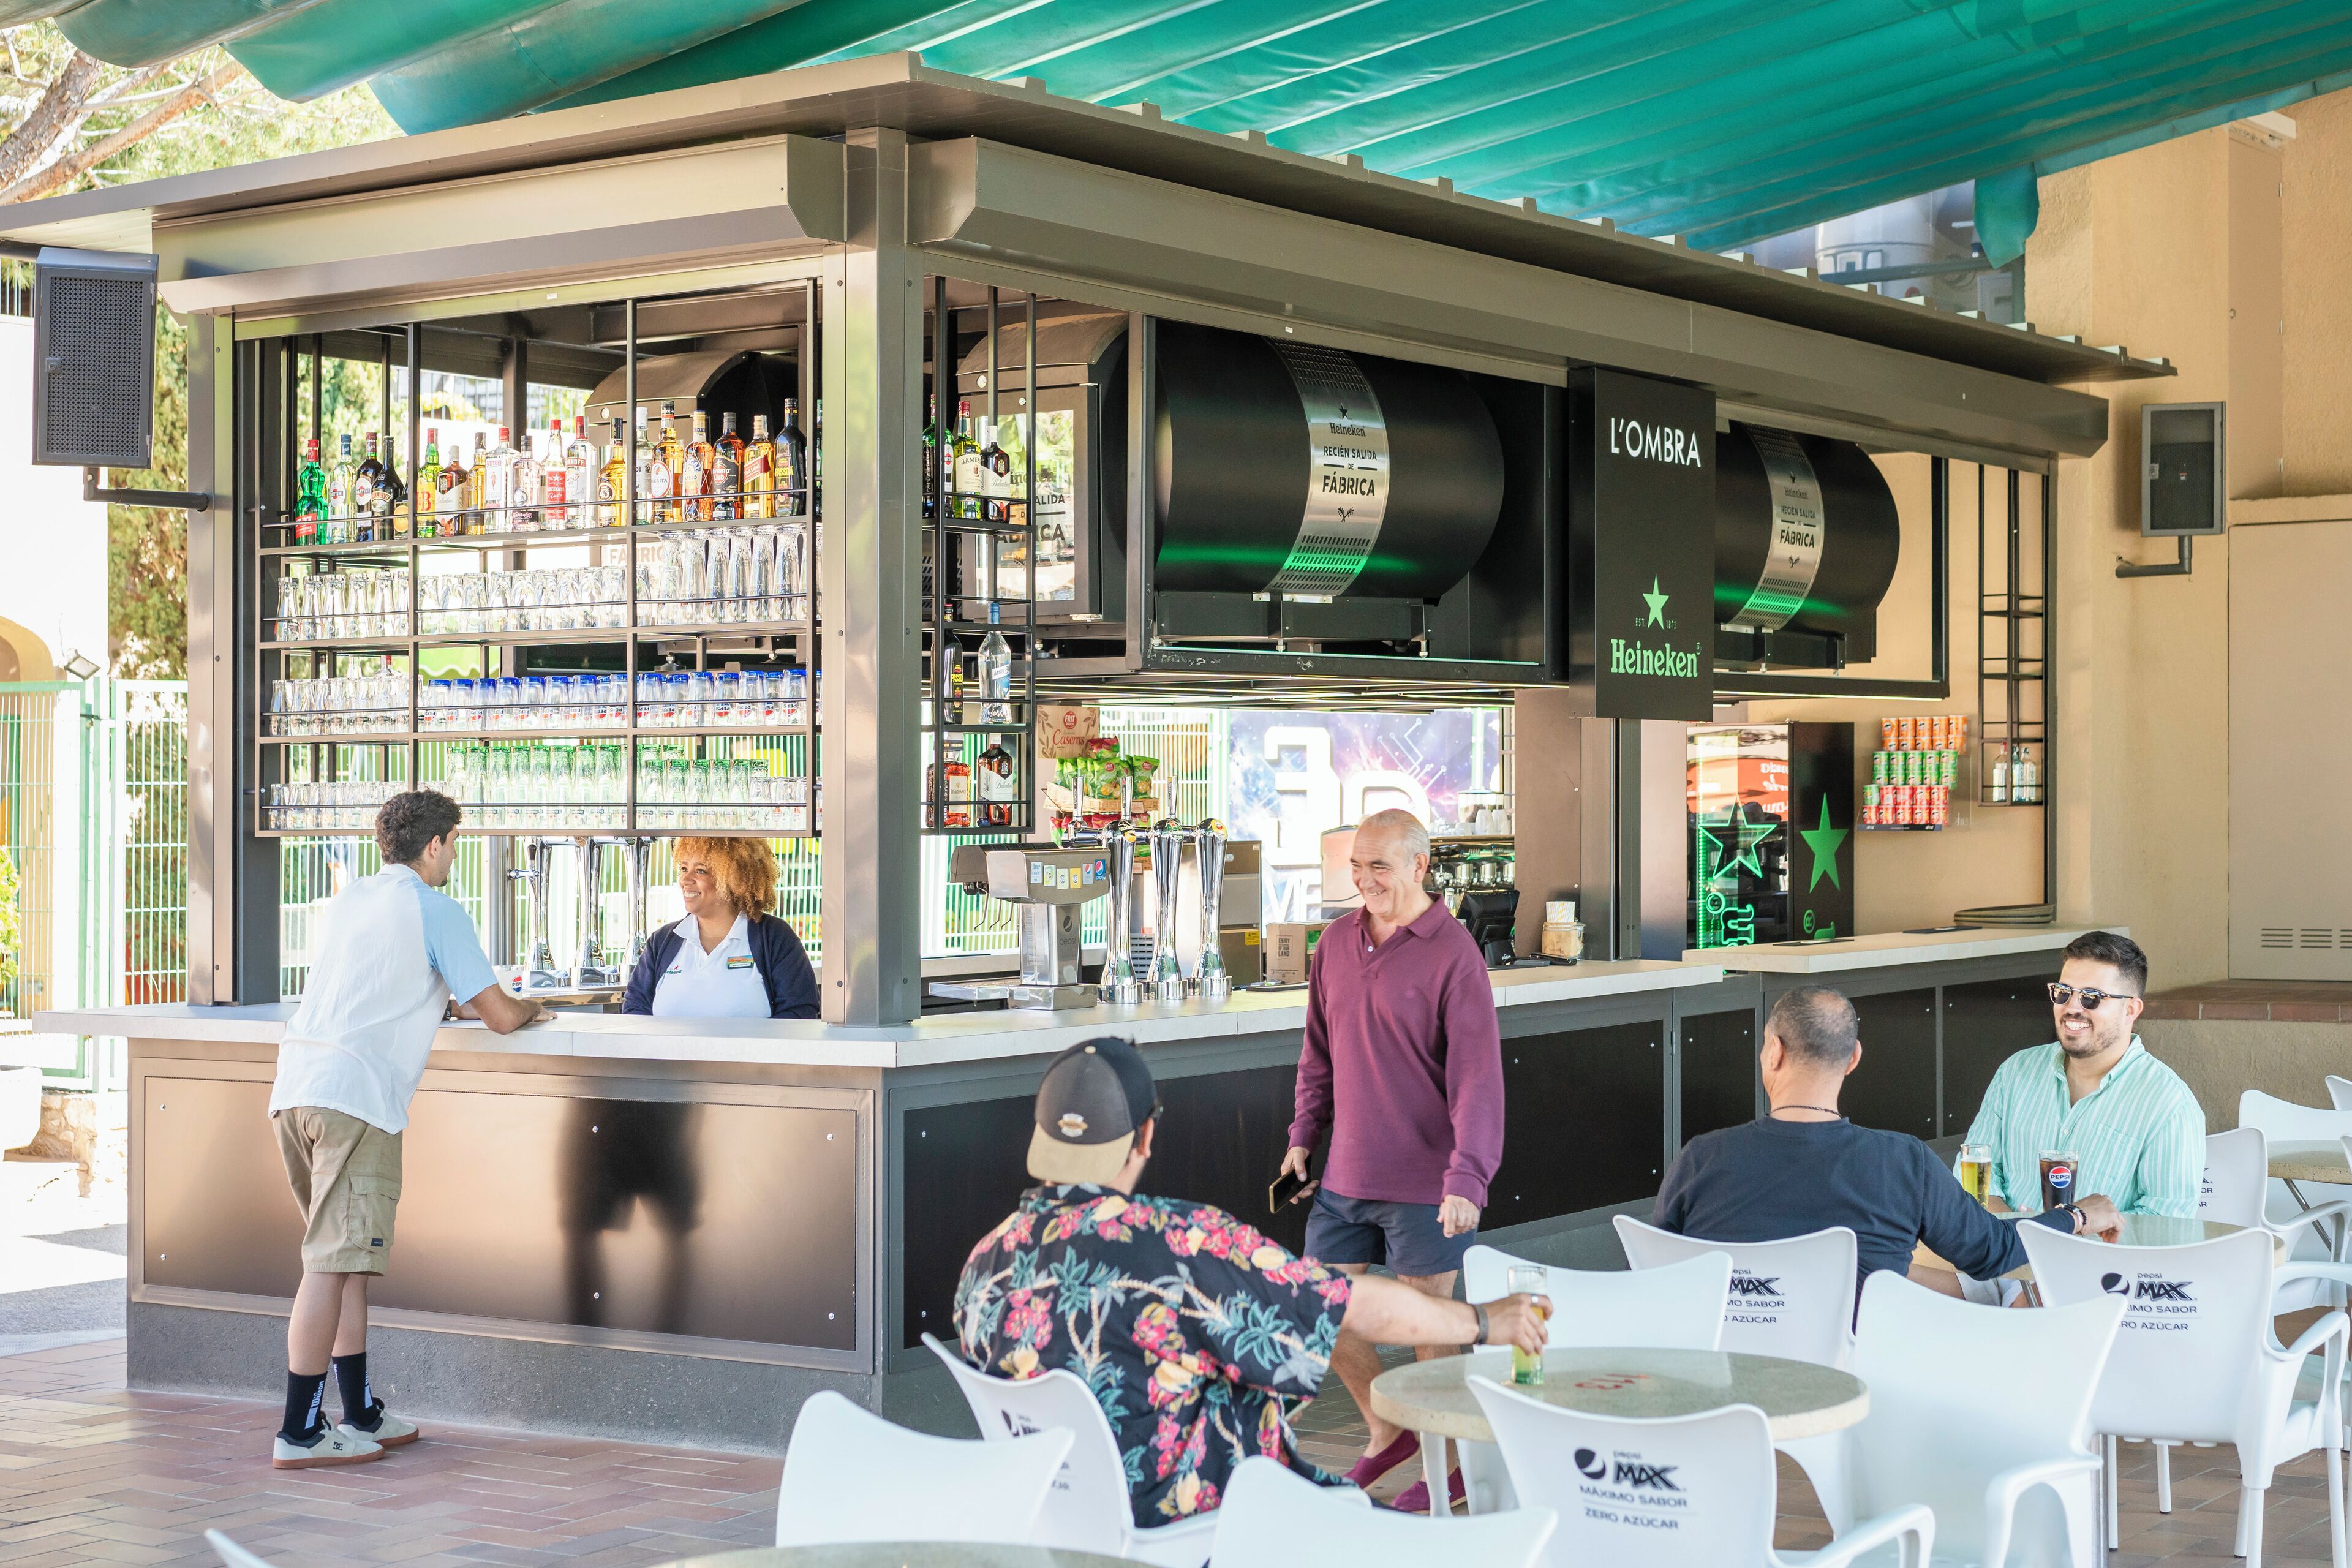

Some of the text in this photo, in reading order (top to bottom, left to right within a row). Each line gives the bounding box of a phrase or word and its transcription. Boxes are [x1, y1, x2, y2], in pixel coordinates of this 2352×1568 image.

[1329, 422, 1366, 437] Heineken
[1611, 417, 1702, 467] L'OMBRA
[1324, 445, 1377, 461] RECIÉN SALIDA
[1322, 471, 1375, 496] FÁBRICA
[1035, 494, 1065, 506] ALIDA
[1781, 505, 1816, 519] RECIÉN SALIDA
[1779, 526, 1814, 548] FÁBRICA
[1611, 639, 1698, 678] Heineken
[1053, 729, 1084, 745] Caseras
[1059, 937, 1076, 946] pepsi
[1729, 1276, 1781, 1296] MAX
[2135, 1280, 2193, 1301] MAX
[312, 1381, 324, 1408] Wilson
[1613, 1461, 1681, 1491] MAX
[1638, 1494, 1687, 1508] SABOR
[1585, 1507, 1618, 1523] ZERO
